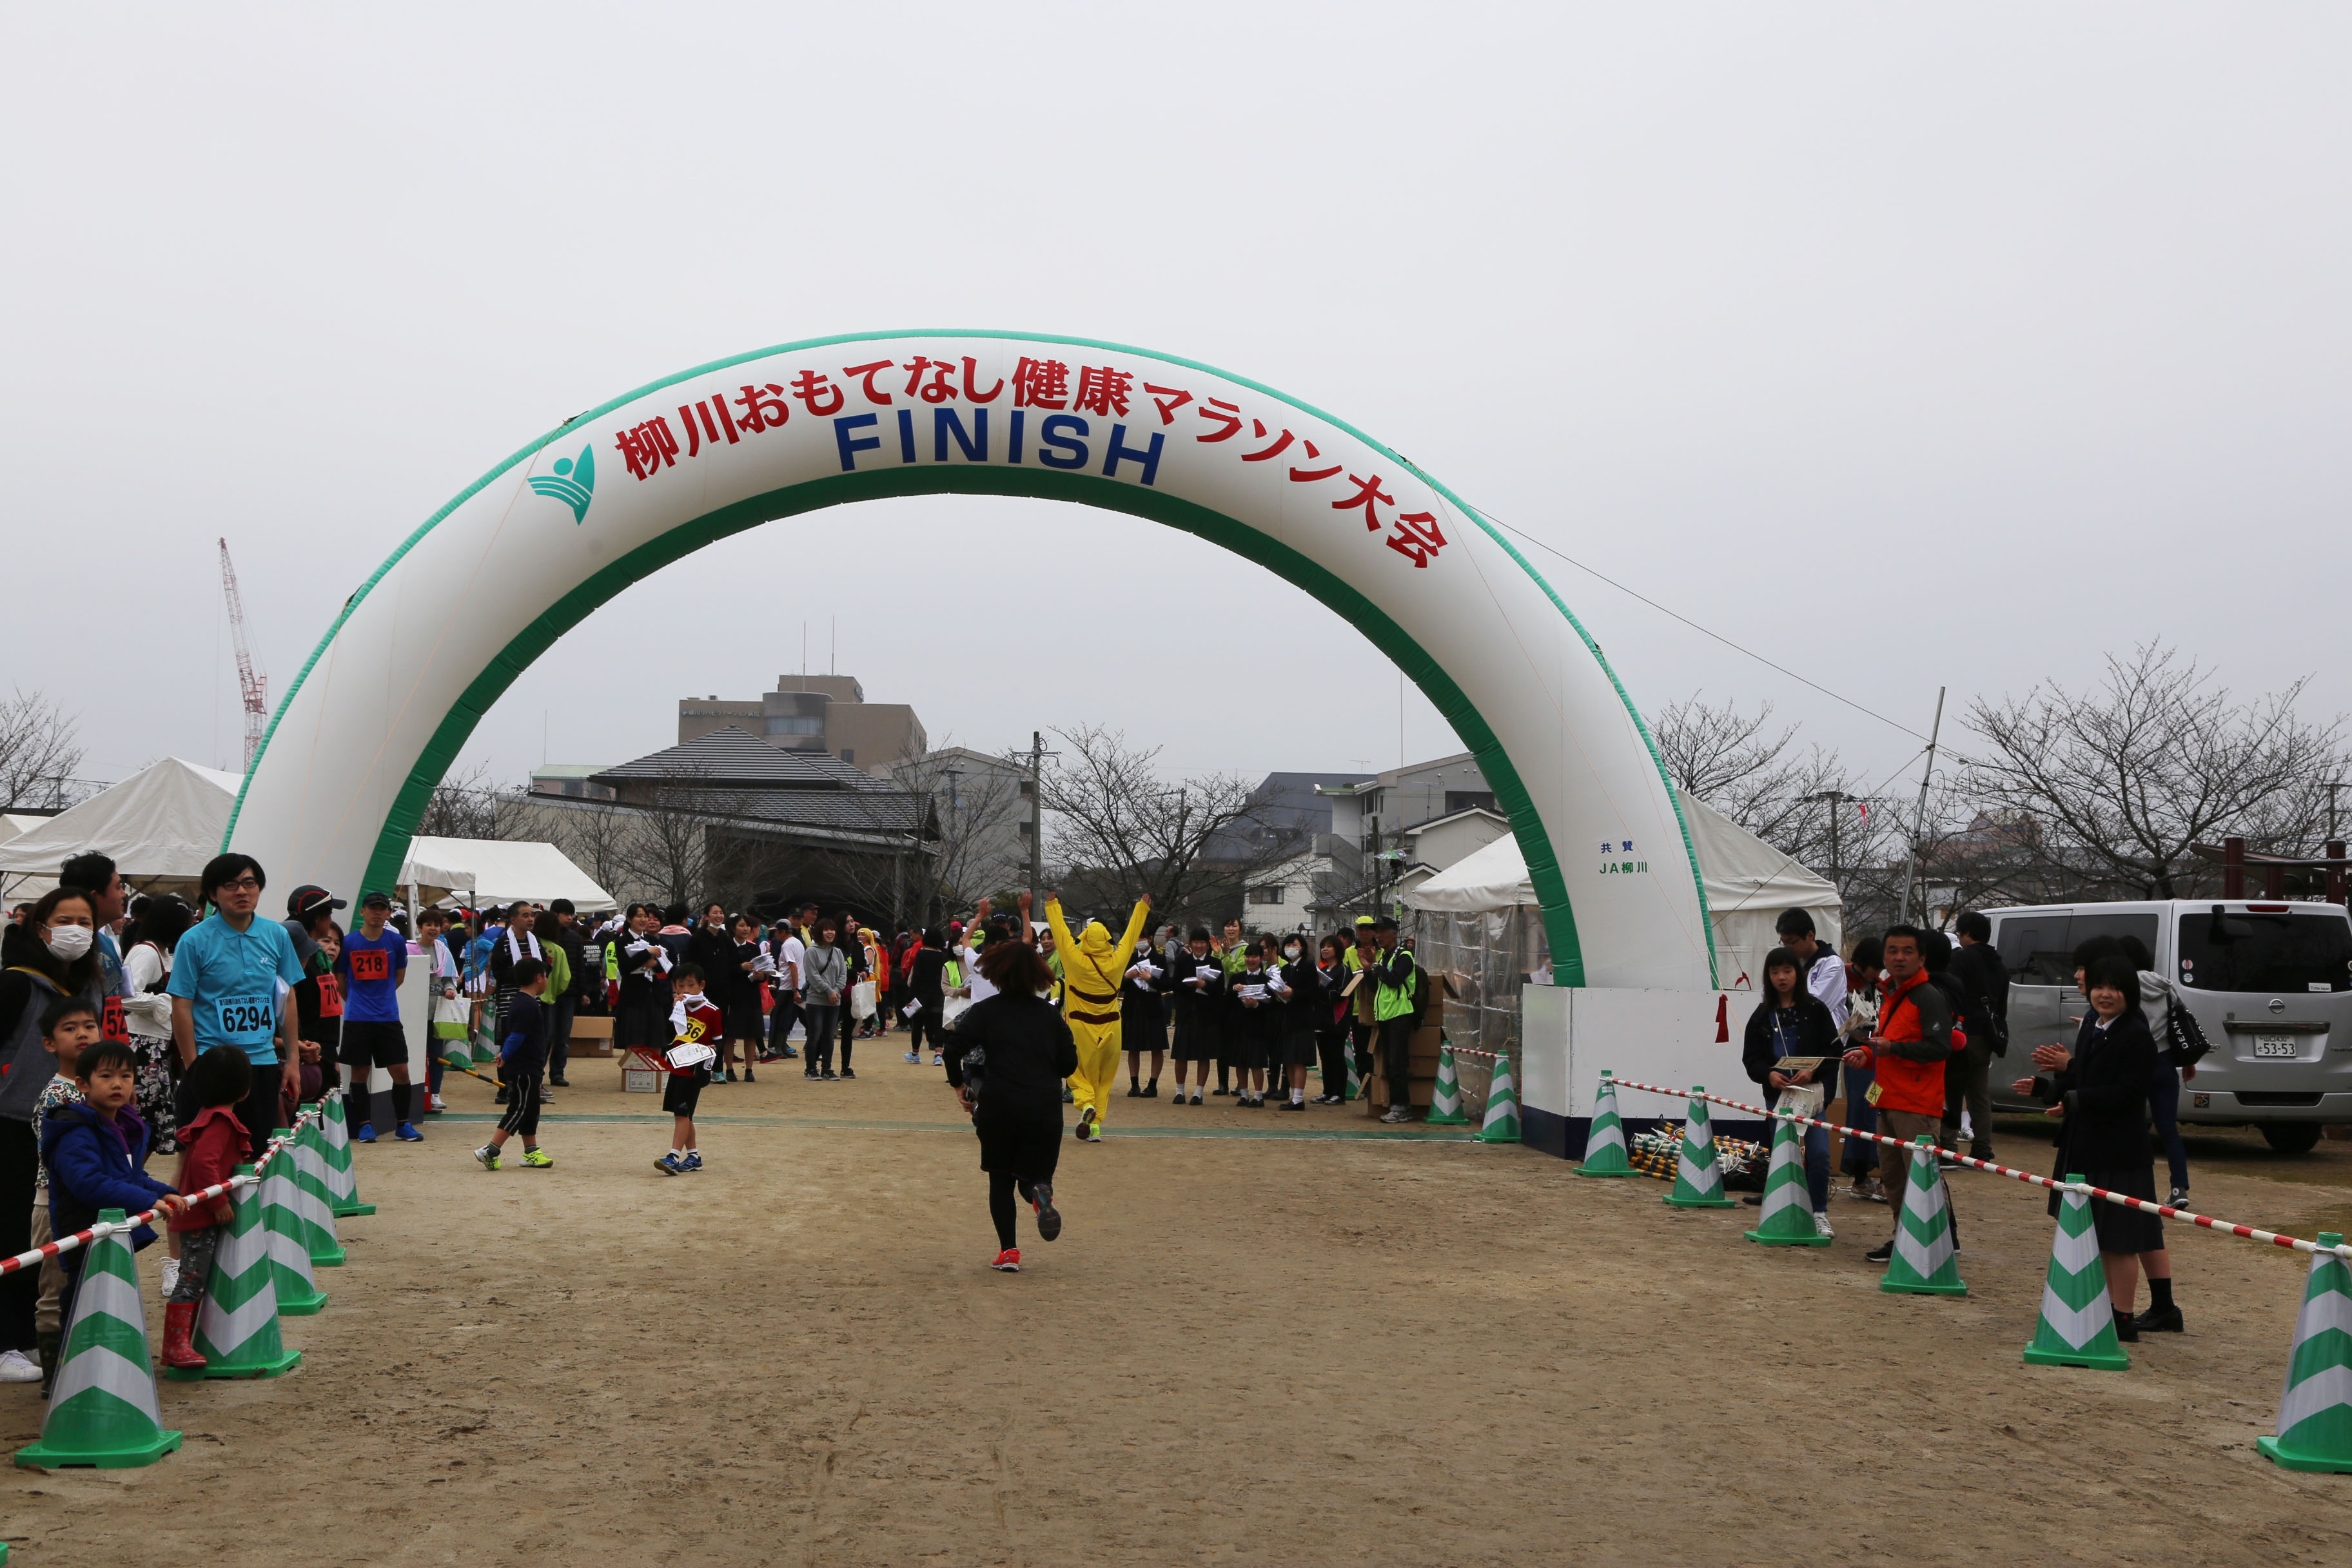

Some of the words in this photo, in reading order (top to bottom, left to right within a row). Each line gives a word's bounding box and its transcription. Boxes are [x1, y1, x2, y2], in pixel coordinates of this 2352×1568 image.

[834, 407, 1165, 486] FINISH
[615, 356, 1448, 569] 柳川おもてなし健康マラソン大会
[356, 957, 383, 973] 218
[222, 1006, 272, 1033] 6294
[2173, 1021, 2189, 1049] DEAN
[2264, 1043, 2295, 1055] 53-53
